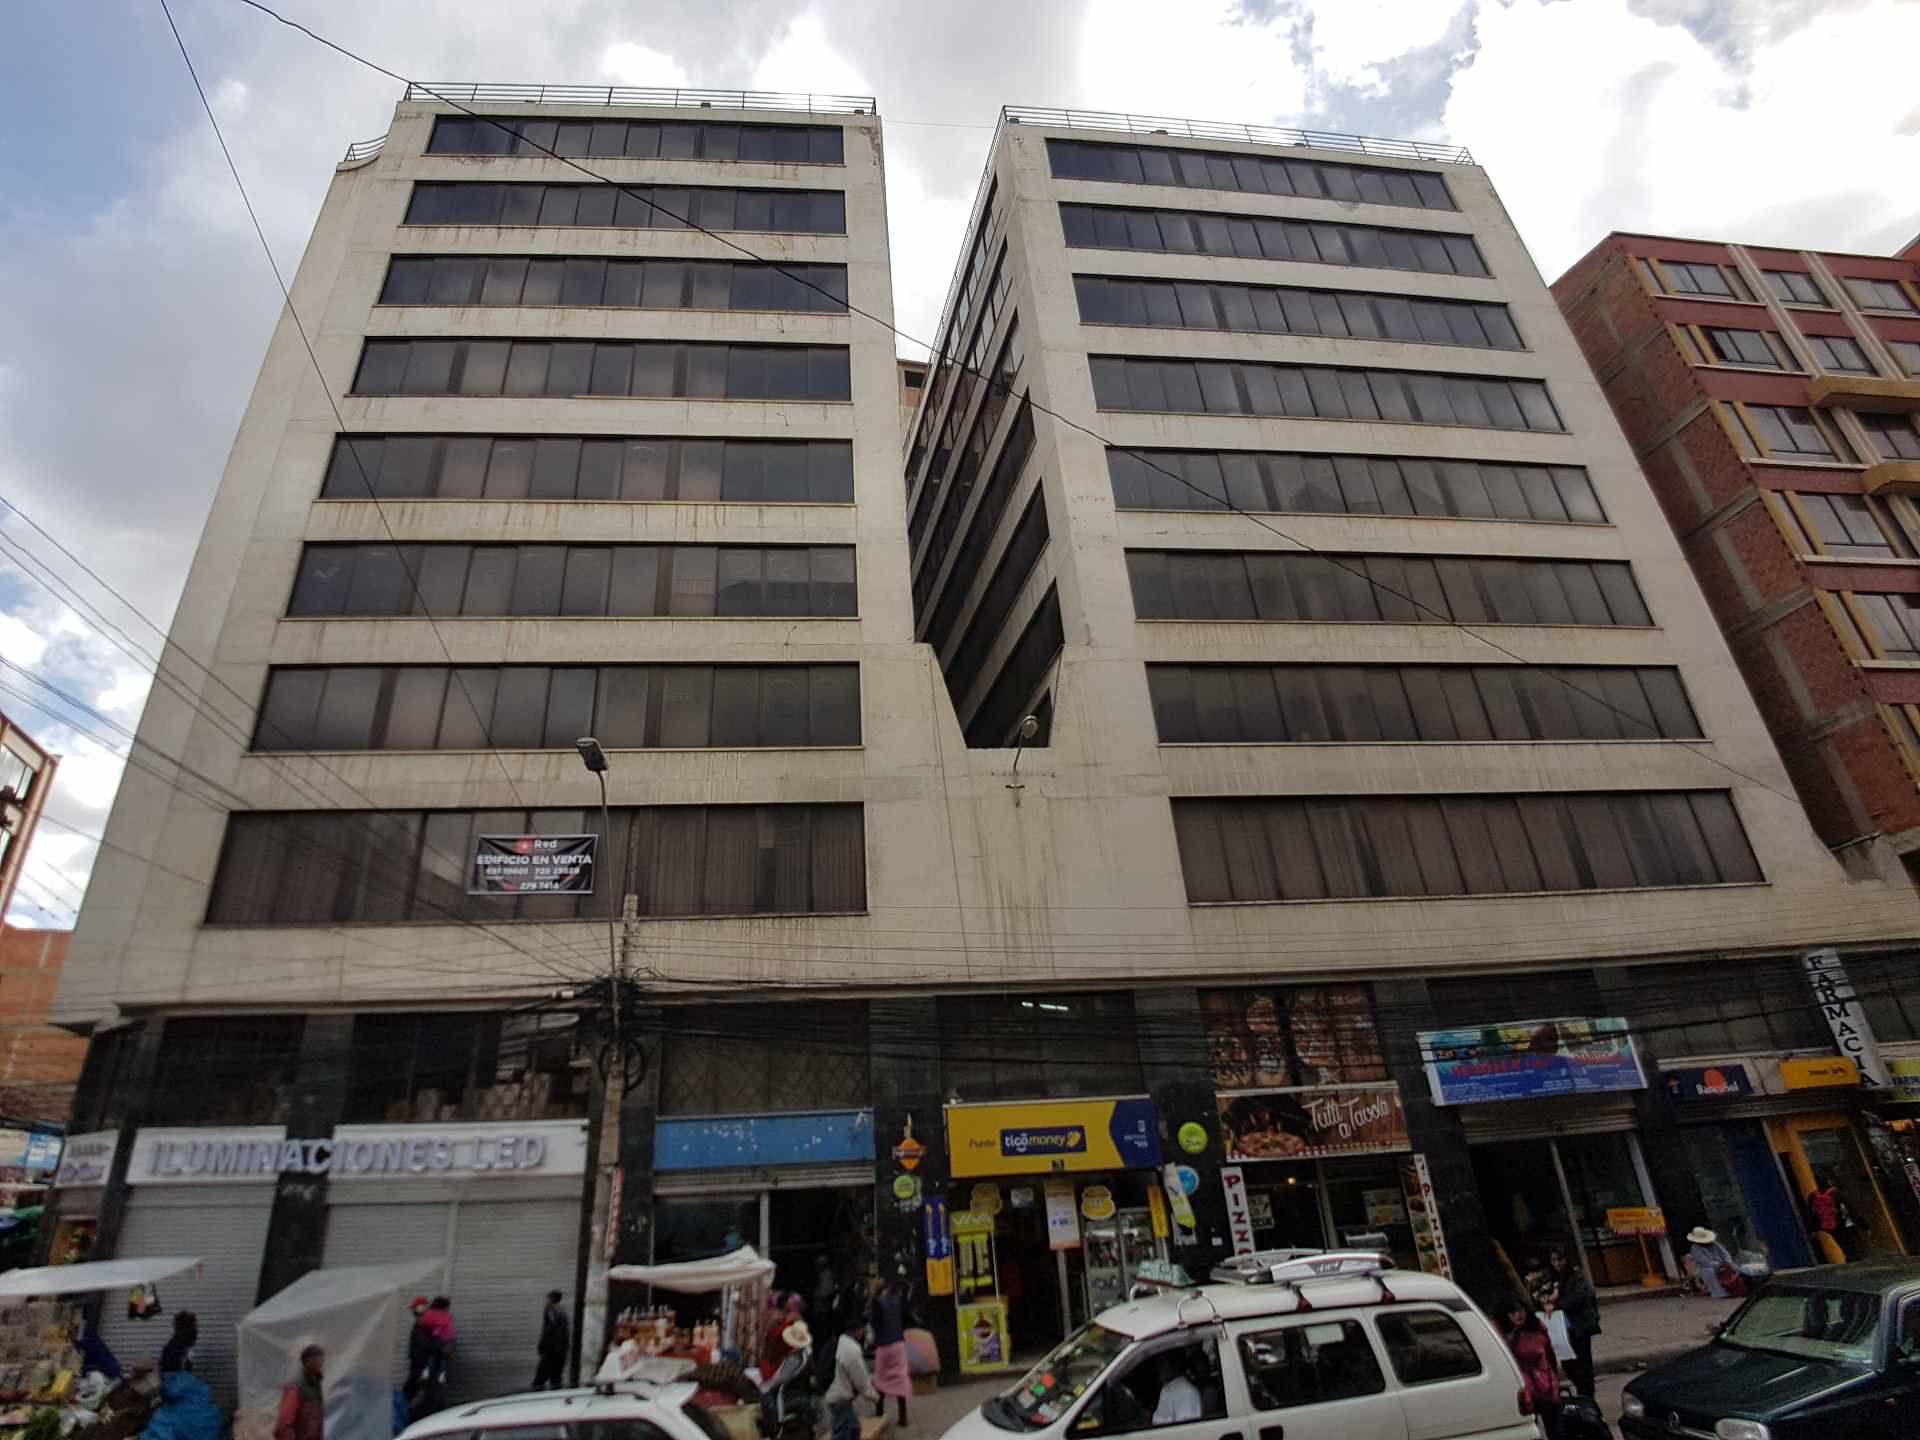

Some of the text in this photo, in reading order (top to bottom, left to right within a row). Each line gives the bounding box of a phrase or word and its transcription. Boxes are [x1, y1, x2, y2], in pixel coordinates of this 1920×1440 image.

[476, 854, 593, 865] EDIFICIO EN VENTA
[534, 839, 557, 849] Red
[1808, 955, 1880, 1086] FARMACIA
[1301, 1095, 1390, 1138] Tutti a Tavola
[149, 1135, 545, 1176] ILUMINACIONES LED
